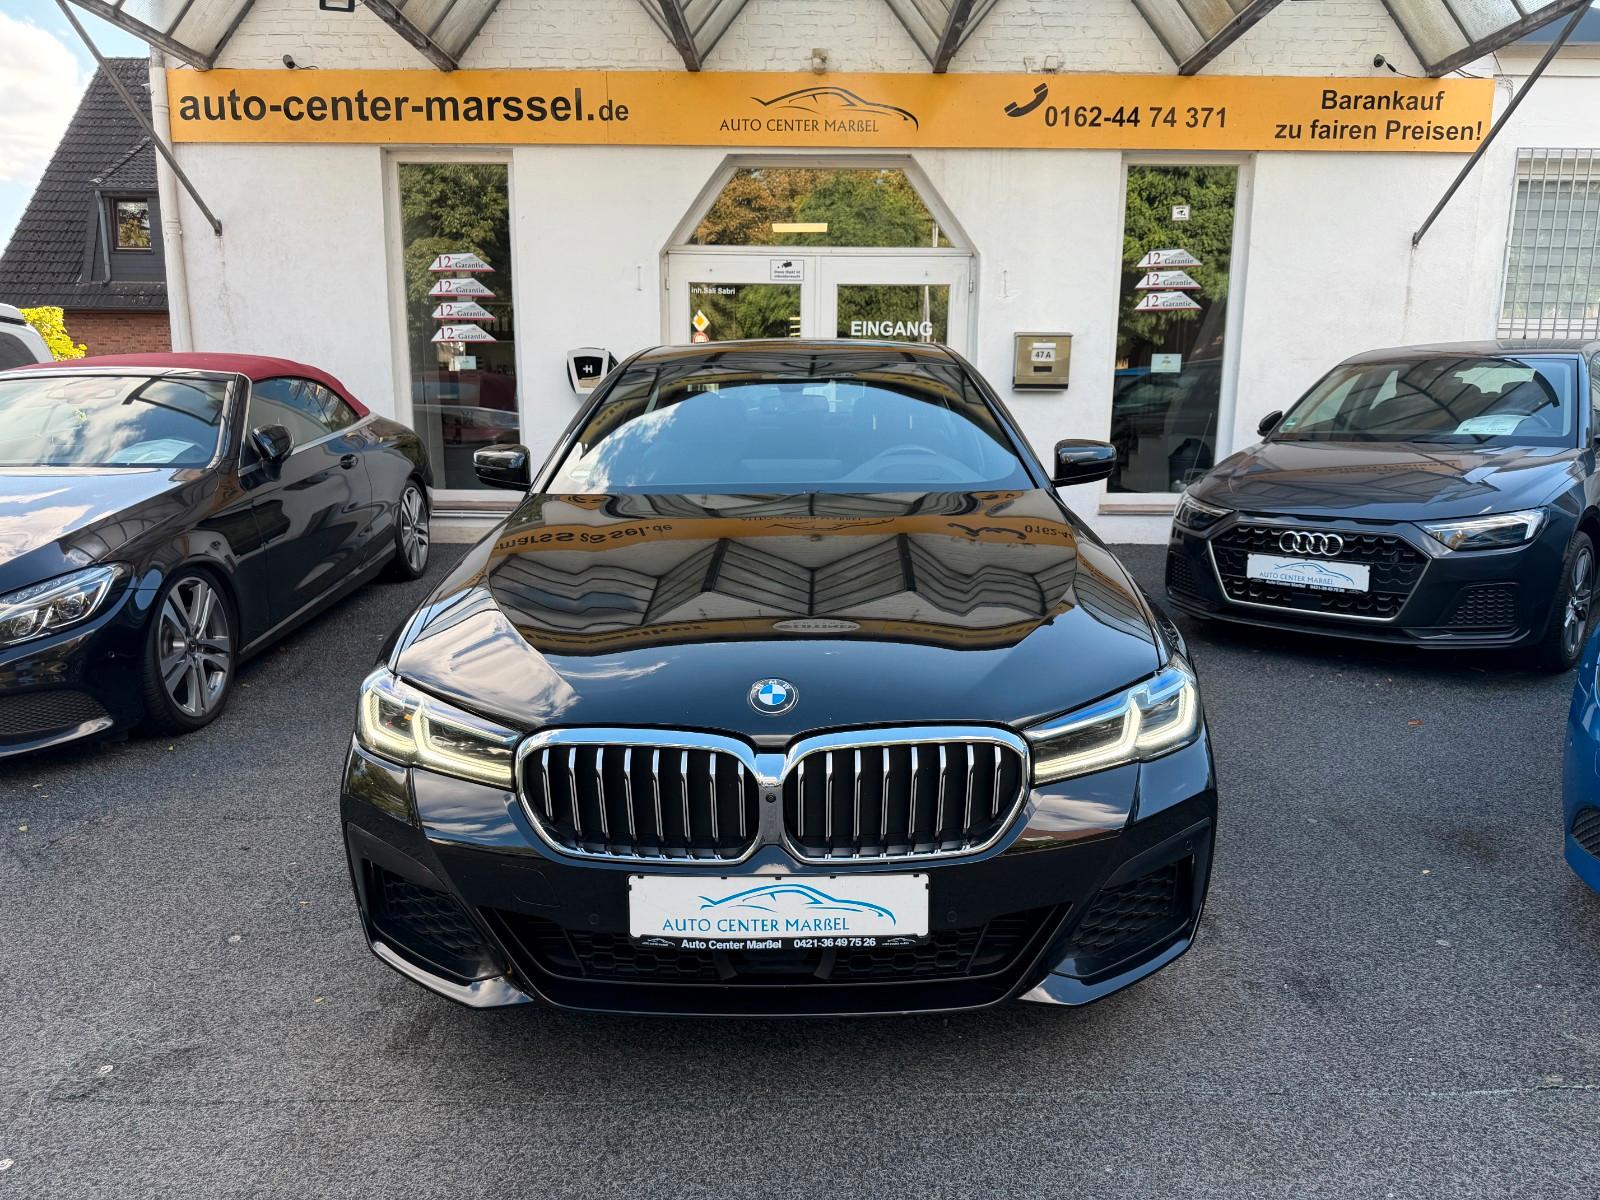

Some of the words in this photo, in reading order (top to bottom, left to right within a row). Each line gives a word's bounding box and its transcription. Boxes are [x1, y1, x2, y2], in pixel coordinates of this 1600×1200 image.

[179, 88, 629, 122] auto-center-marssel.de
[1321, 90, 1445, 112] Barankauf
[1044, 106, 1140, 128] 0162-44
[1150, 107, 1177, 128] 74
[1186, 107, 1227, 129] 371
[719, 119, 762, 132] AUTO
[766, 119, 819, 132] CENTER
[1275, 123, 1301, 140] zu
[1310, 120, 1377, 140] fairen
[1385, 120, 1483, 142] Preisen!
[438, 255, 452, 268] 12
[1147, 252, 1161, 264] 12
[1145, 273, 1159, 286] 12
[438, 280, 452, 293] 12
[718, 287, 736, 295] Sabri
[1144, 295, 1159, 307] 12
[439, 304, 453, 316] 12
[440, 327, 454, 339] 12
[851, 321, 933, 336] EINGANG
[662, 918, 711, 932] AUTO
[717, 918, 779, 932] CENTER
[681, 939, 706, 949] Auto
[708, 940, 745, 950] Center
[793, 938, 834, 948] 0421-36
[835, 938, 848, 947] 49
[849, 938, 862, 947] 75
[863, 937, 876, 947] 26
